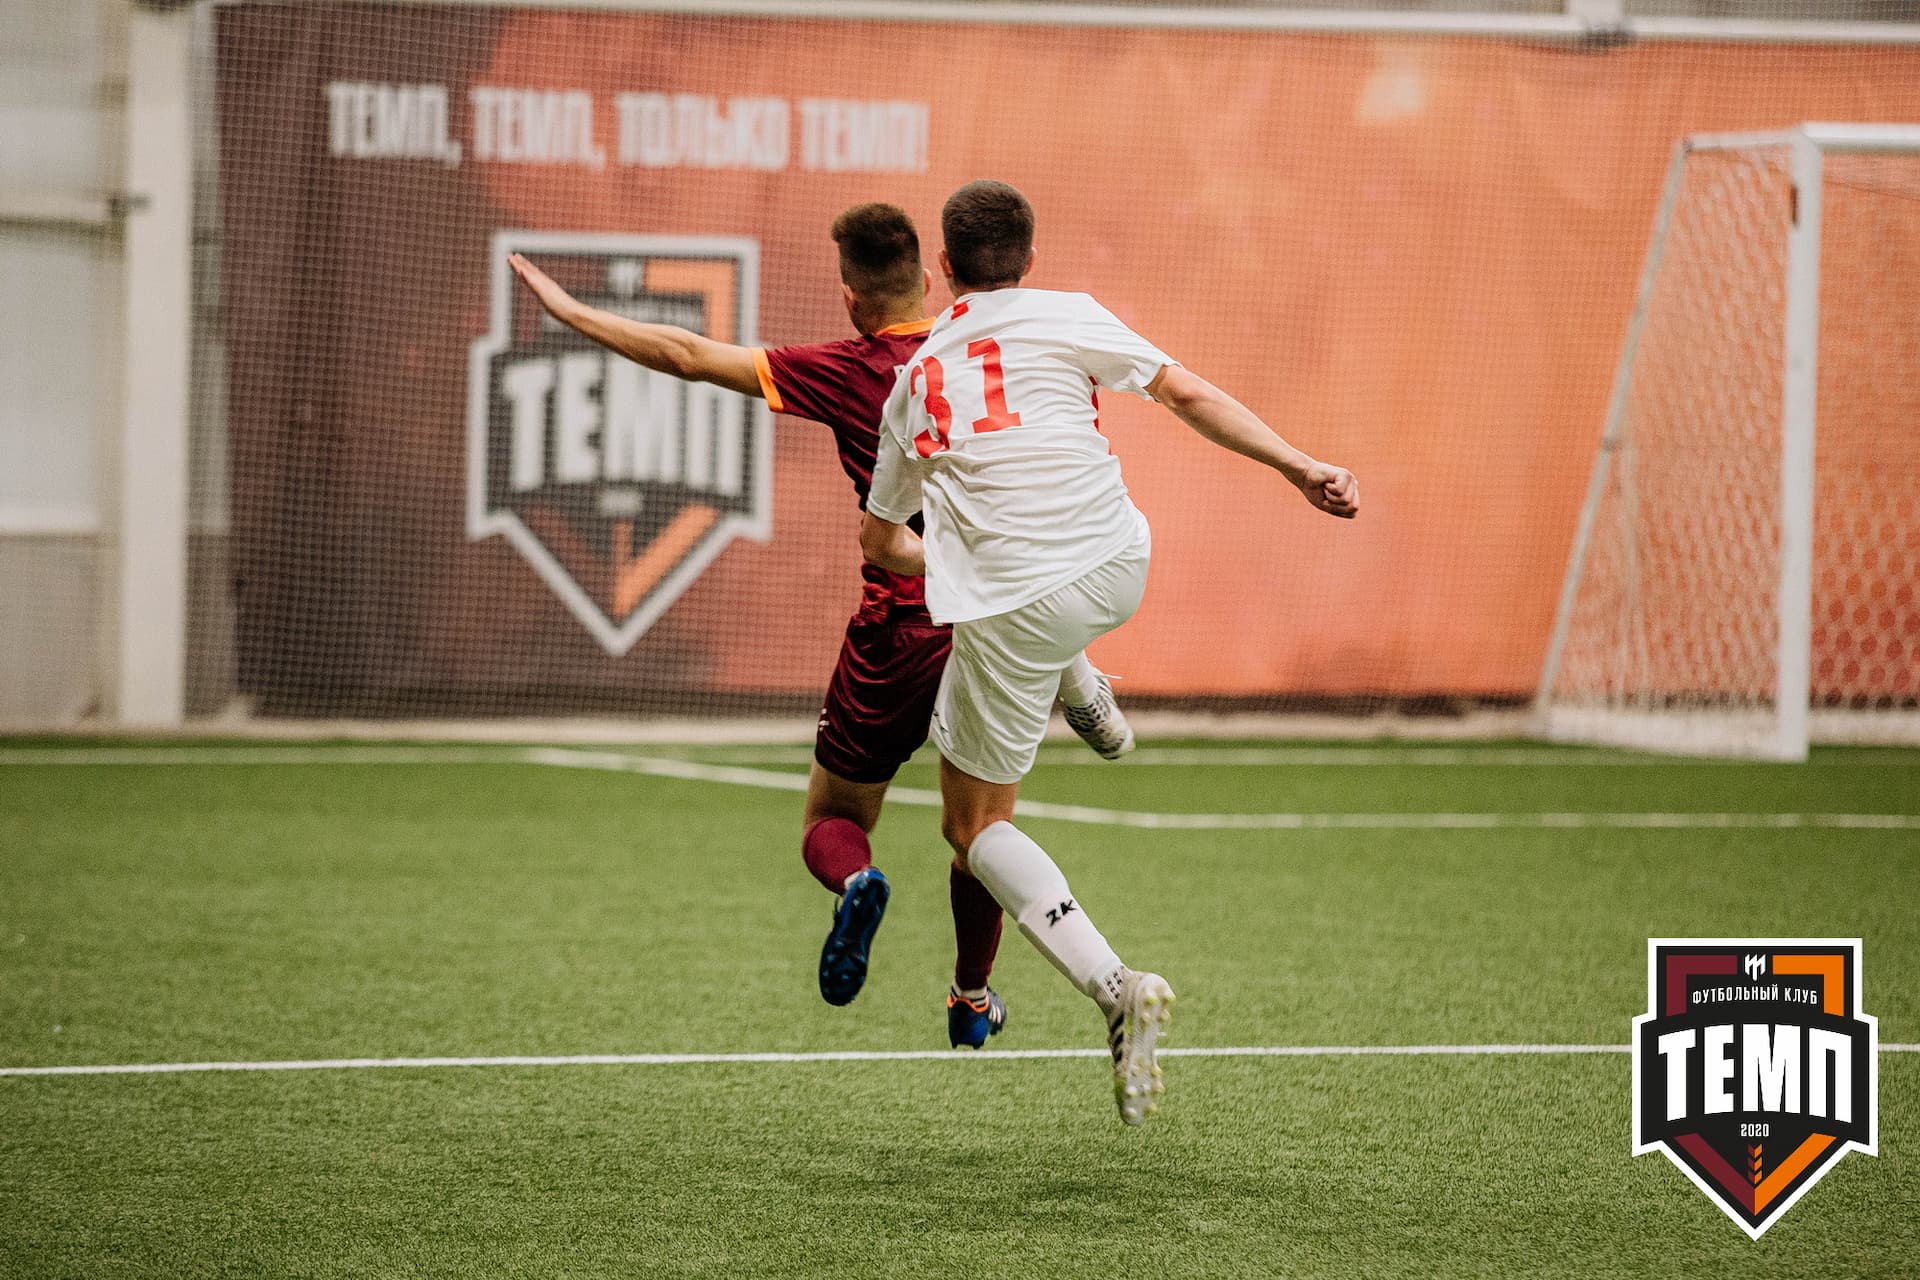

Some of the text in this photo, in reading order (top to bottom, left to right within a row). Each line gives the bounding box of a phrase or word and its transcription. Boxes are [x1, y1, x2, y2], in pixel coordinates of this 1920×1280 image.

[328, 83, 461, 168] ТЕМП,
[471, 87, 606, 169] ТЕМП,
[614, 91, 790, 170] ТОЛЬКО
[911, 337, 1022, 458] 31
